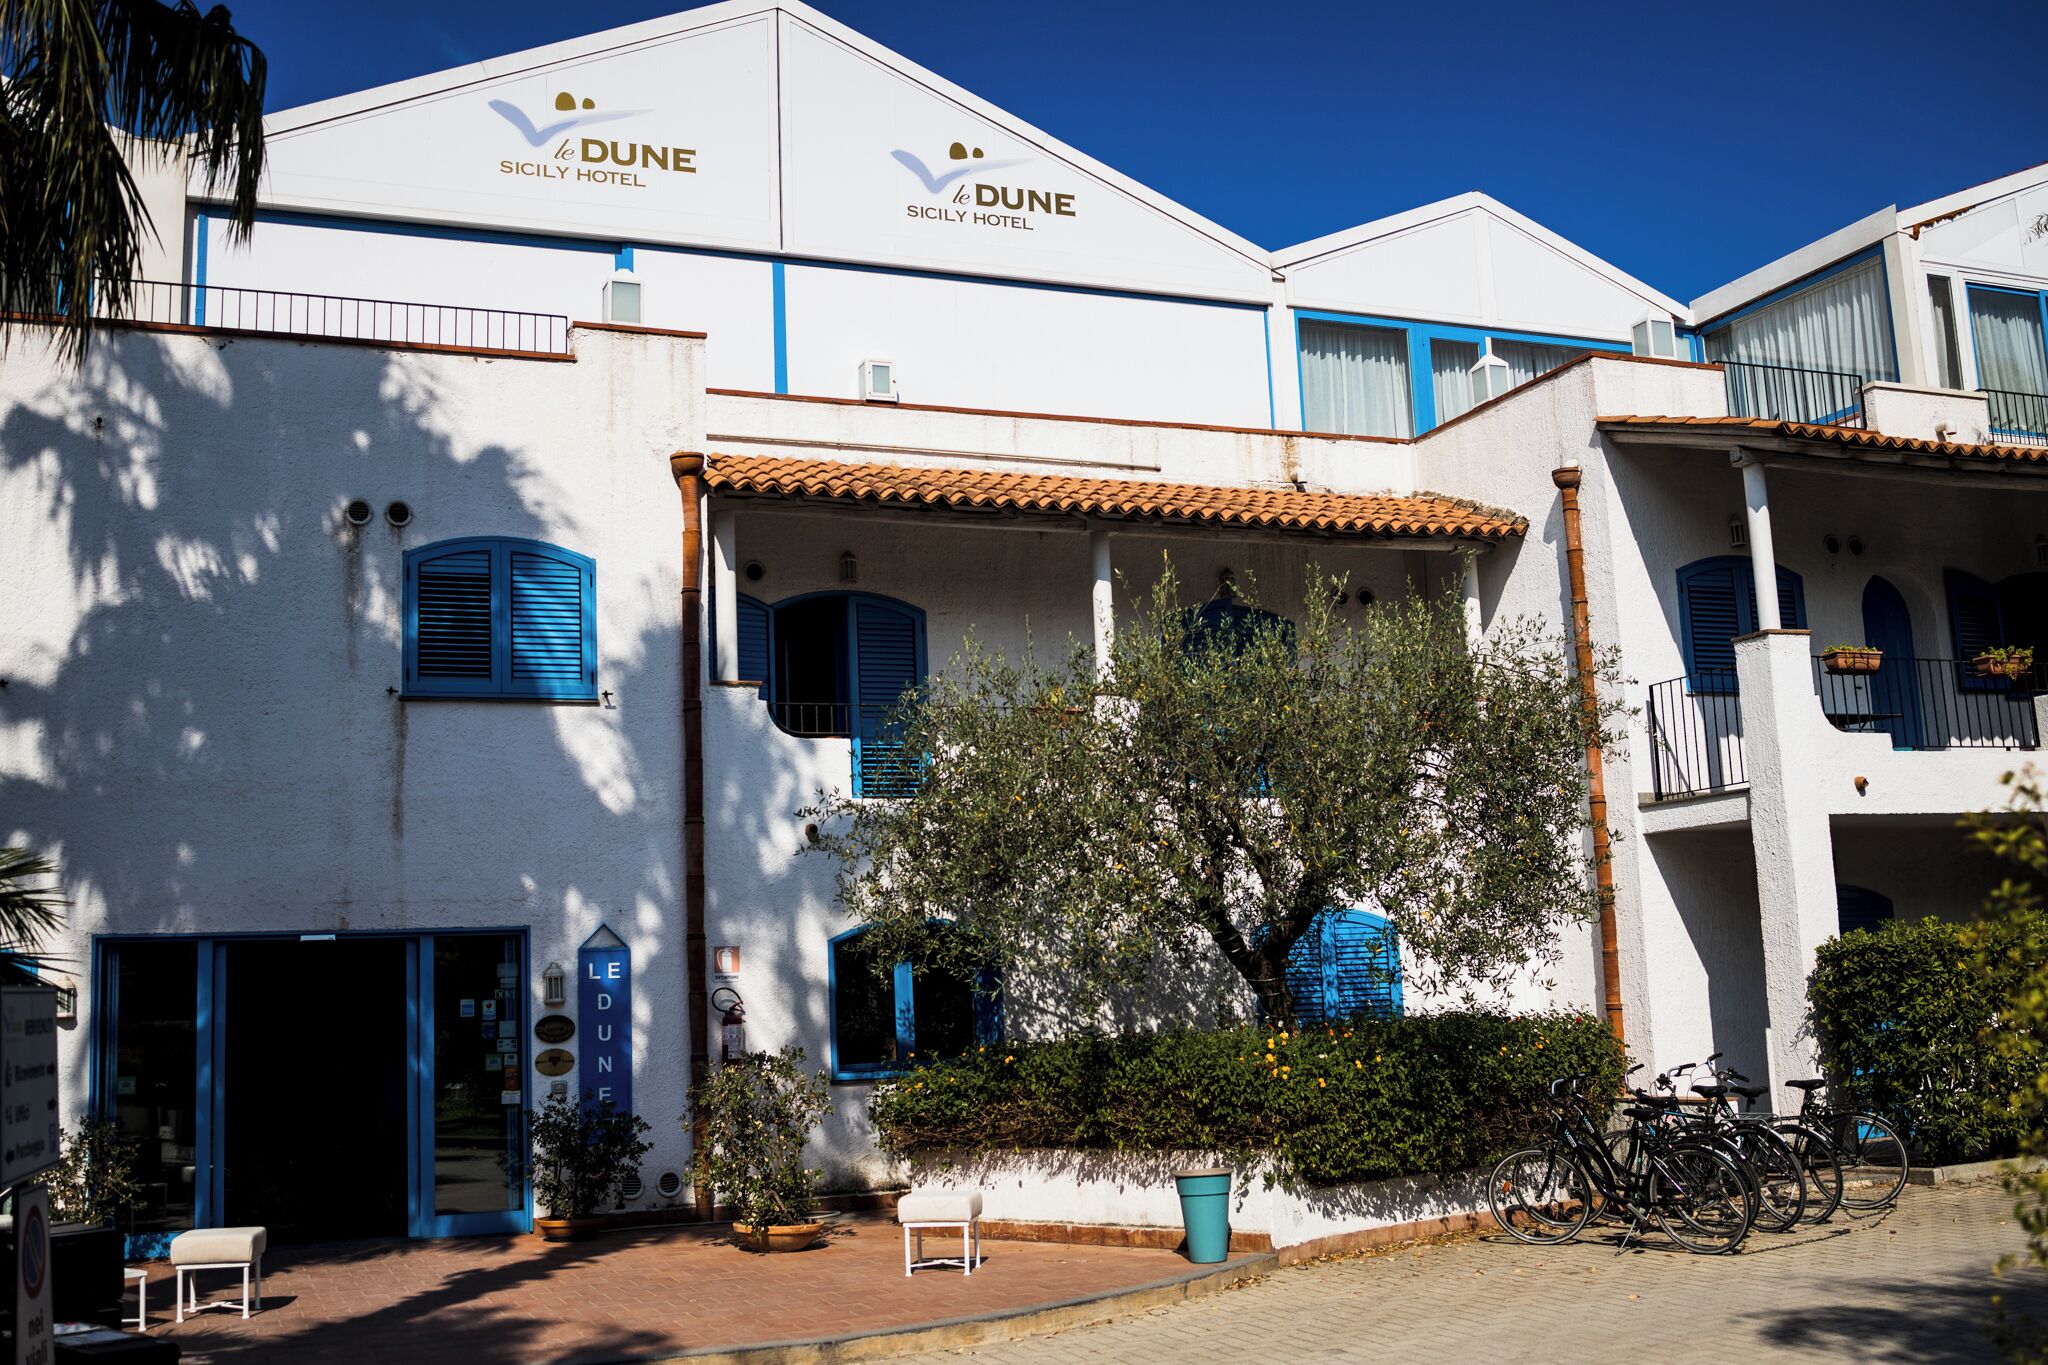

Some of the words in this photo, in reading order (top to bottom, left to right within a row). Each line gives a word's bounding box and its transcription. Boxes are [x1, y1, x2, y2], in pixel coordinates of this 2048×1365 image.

[554, 138, 575, 161] le
[581, 137, 697, 174] DUNE
[500, 160, 570, 179] SICILY
[577, 168, 646, 187] HOTEL
[952, 184, 971, 205] le
[975, 183, 1076, 217] DUNE
[907, 205, 967, 223] SICILY
[973, 212, 1034, 230] HOTEL
[589, 962, 621, 979] LE
